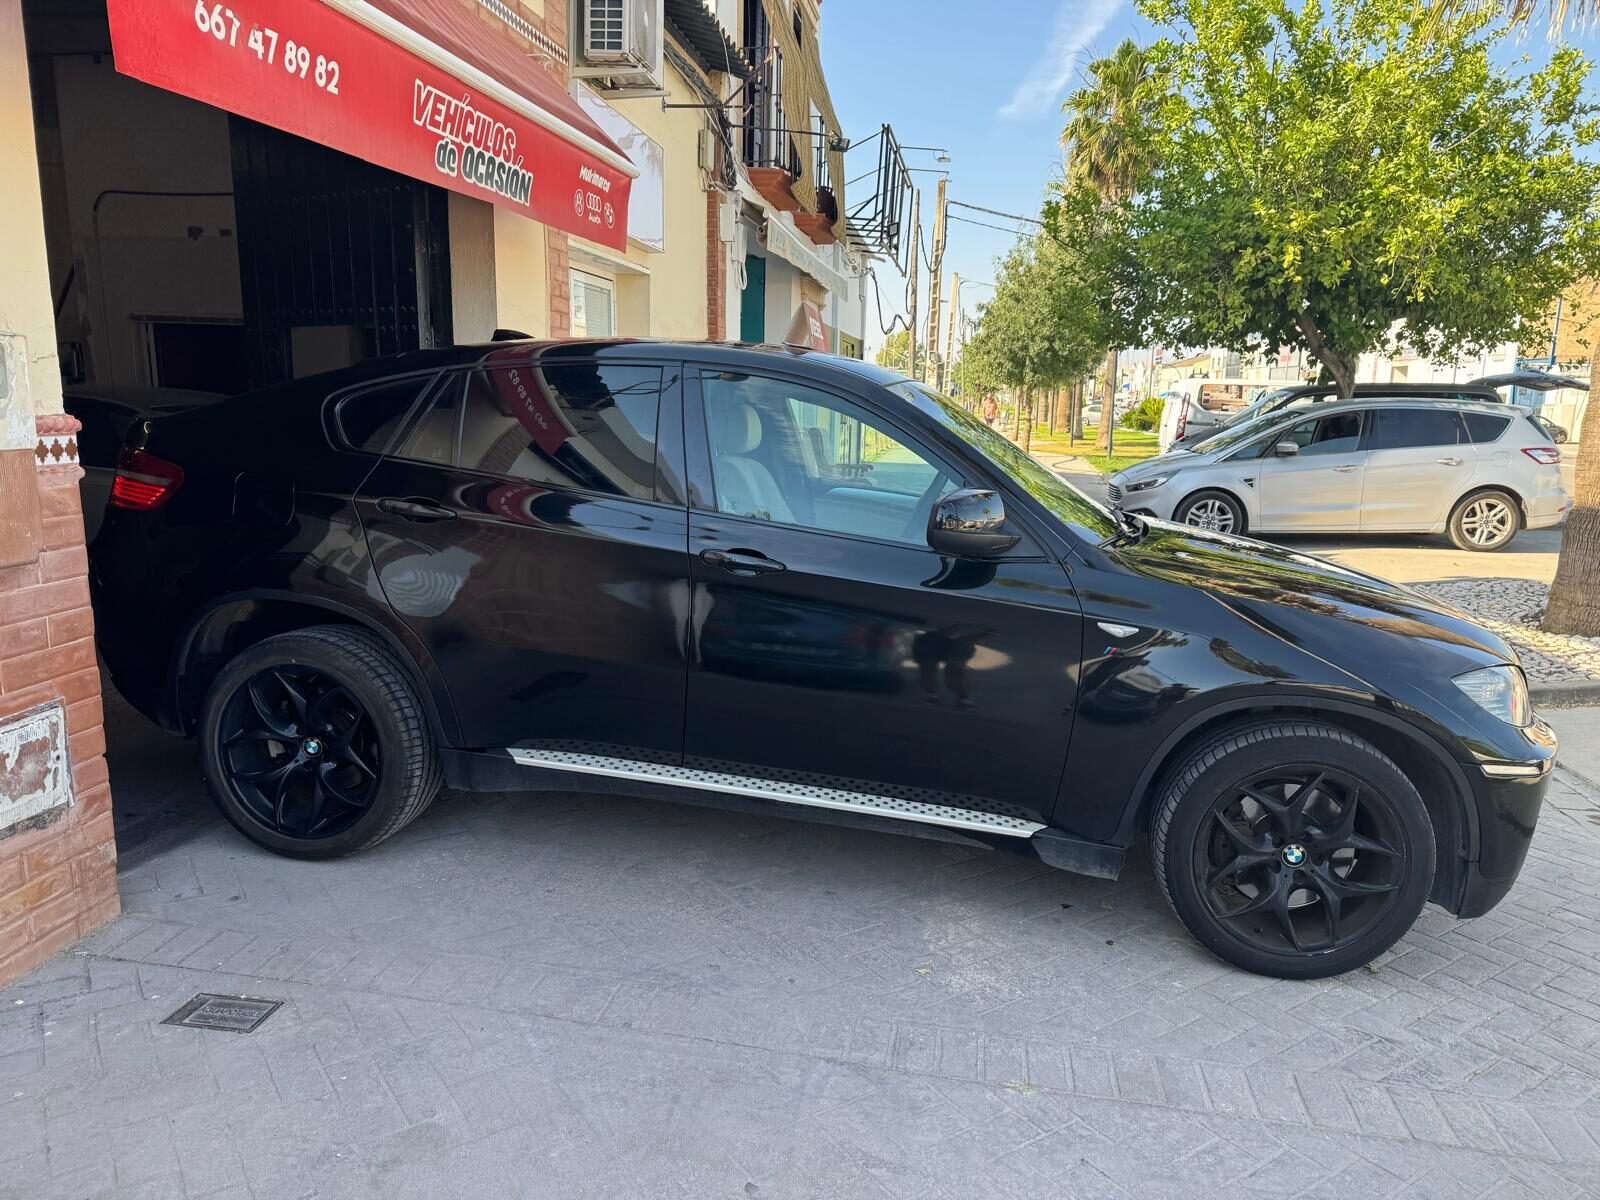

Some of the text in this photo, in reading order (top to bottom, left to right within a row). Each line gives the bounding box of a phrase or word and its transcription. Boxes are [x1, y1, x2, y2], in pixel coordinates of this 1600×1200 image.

[194, 0, 340, 96] 667 47 89 82
[413, 78, 517, 164] VEHÍCULOS
[435, 138, 534, 207] de OCASIÓN
